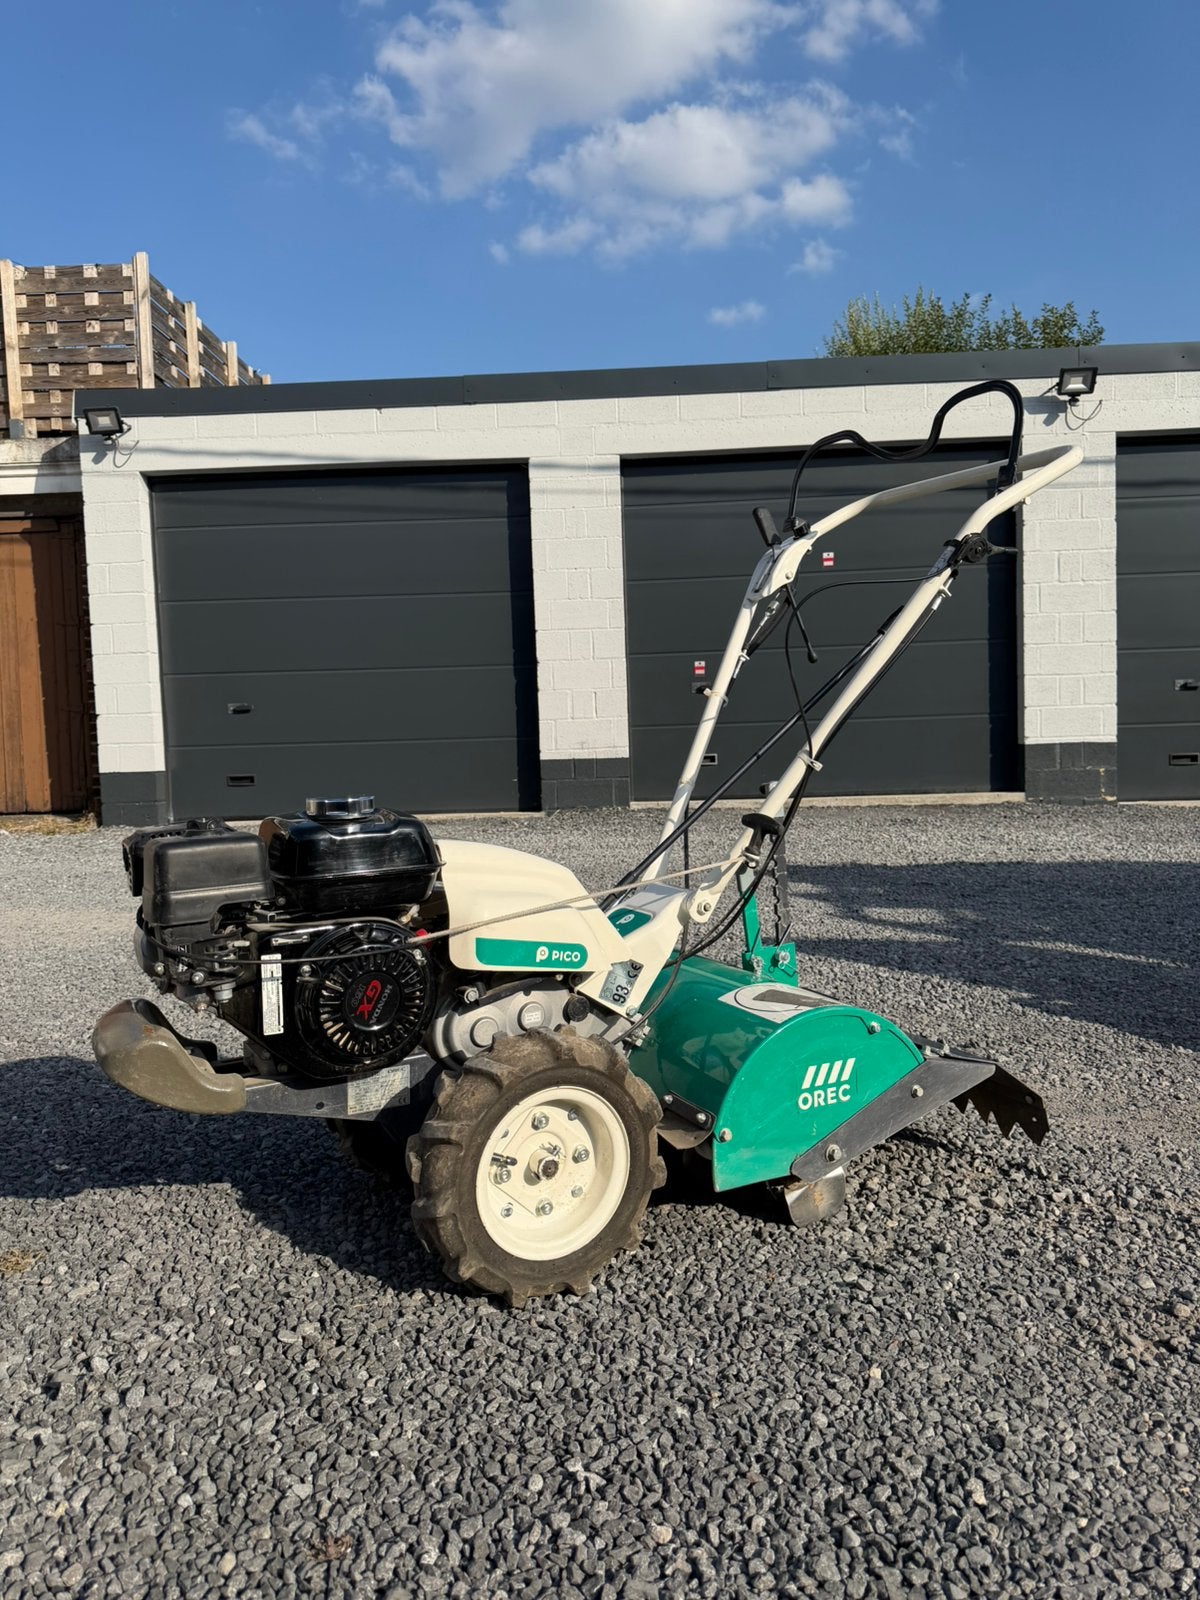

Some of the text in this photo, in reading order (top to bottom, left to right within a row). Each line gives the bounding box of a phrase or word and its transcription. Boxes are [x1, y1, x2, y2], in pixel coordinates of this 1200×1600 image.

[552, 950, 581, 962] PICO
[627, 962, 642, 978] CE
[355, 979, 382, 1021] GX
[369, 984, 393, 1024] HONDA
[612, 984, 630, 1004] 93
[797, 1083, 851, 1110] OREC
